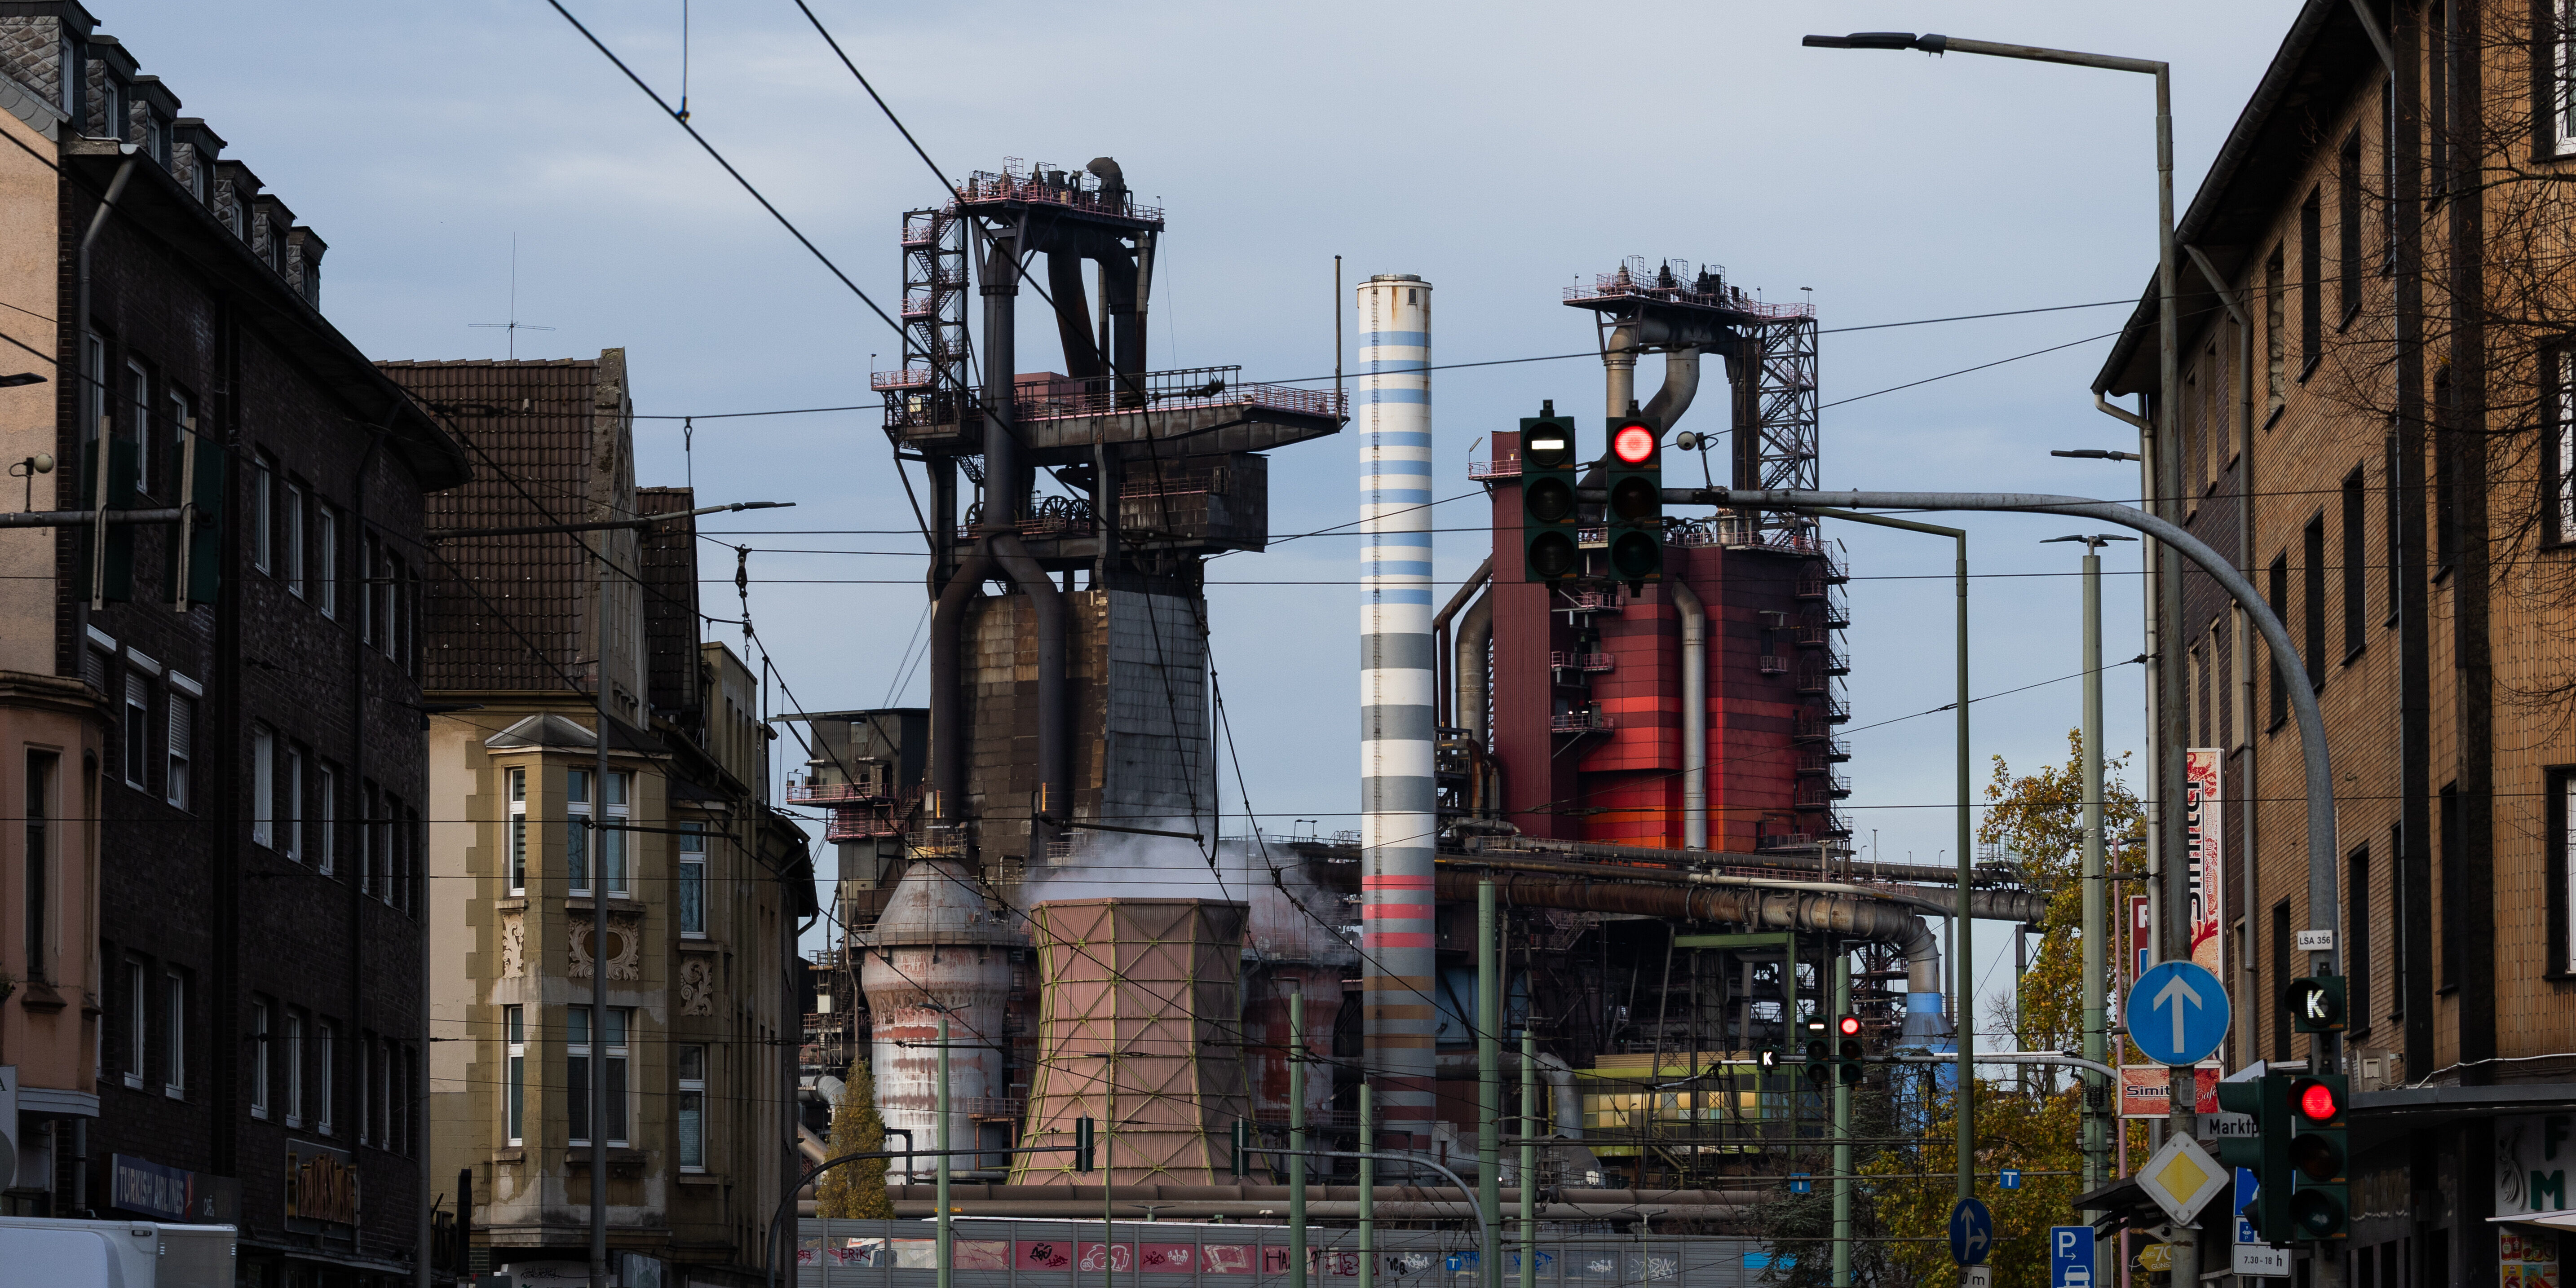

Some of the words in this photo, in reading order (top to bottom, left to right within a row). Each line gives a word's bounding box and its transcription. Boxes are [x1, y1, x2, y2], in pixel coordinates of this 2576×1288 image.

[2300, 937, 2315, 945] LSA
[2317, 936, 2331, 944] 356
[2307, 989, 2326, 1018] K
[1763, 1052, 1772, 1065] K
[2003, 1172, 2017, 1186] T
[119, 1166, 152, 1207] TURKISH
[154, 1175, 184, 1214] AIRLINES
[2059, 1231, 2076, 1258] P
[2265, 1257, 2271, 1265] 18
[2277, 1255, 2282, 1266] h
[1972, 1276, 1984, 1285] m
